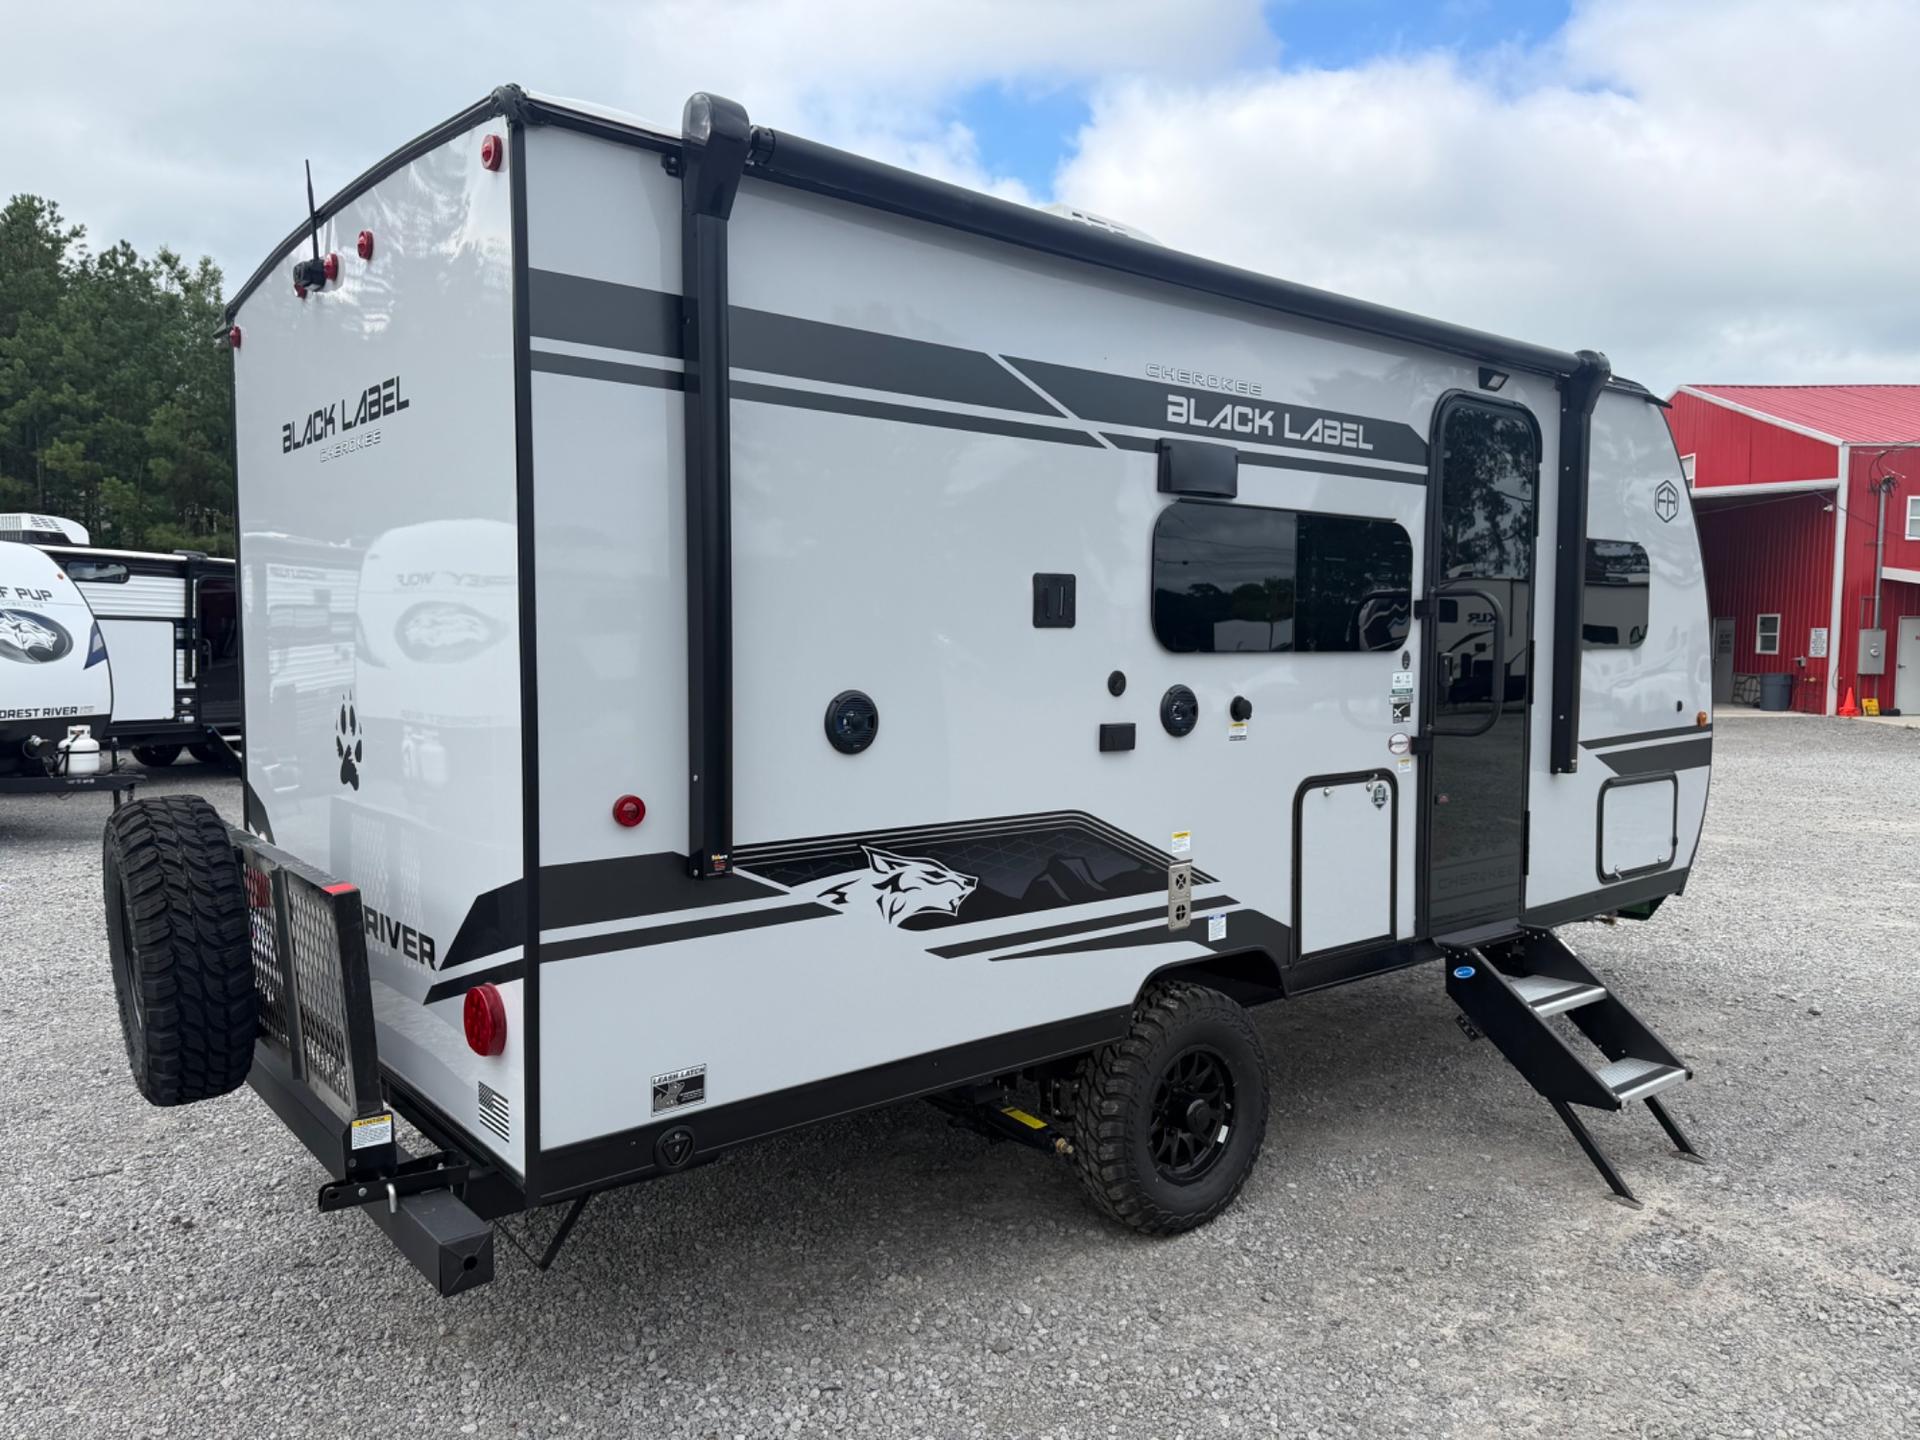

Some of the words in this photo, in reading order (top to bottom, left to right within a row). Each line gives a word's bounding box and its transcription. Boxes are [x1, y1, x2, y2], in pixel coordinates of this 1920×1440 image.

[1146, 363, 1263, 396] CHEROKEE
[282, 403, 336, 454] BLACK
[342, 375, 410, 431] LABEL
[1167, 394, 1274, 436] BLACK
[1284, 413, 1374, 450] LABEL
[320, 428, 382, 463] CHEROKEE
[14, 587, 53, 601] PUP
[0, 708, 40, 719] OREST
[43, 706, 78, 717] RIVER
[363, 904, 437, 971] RIVER
[653, 1073, 679, 1085] LEASH
[680, 1067, 705, 1078] LATCH
